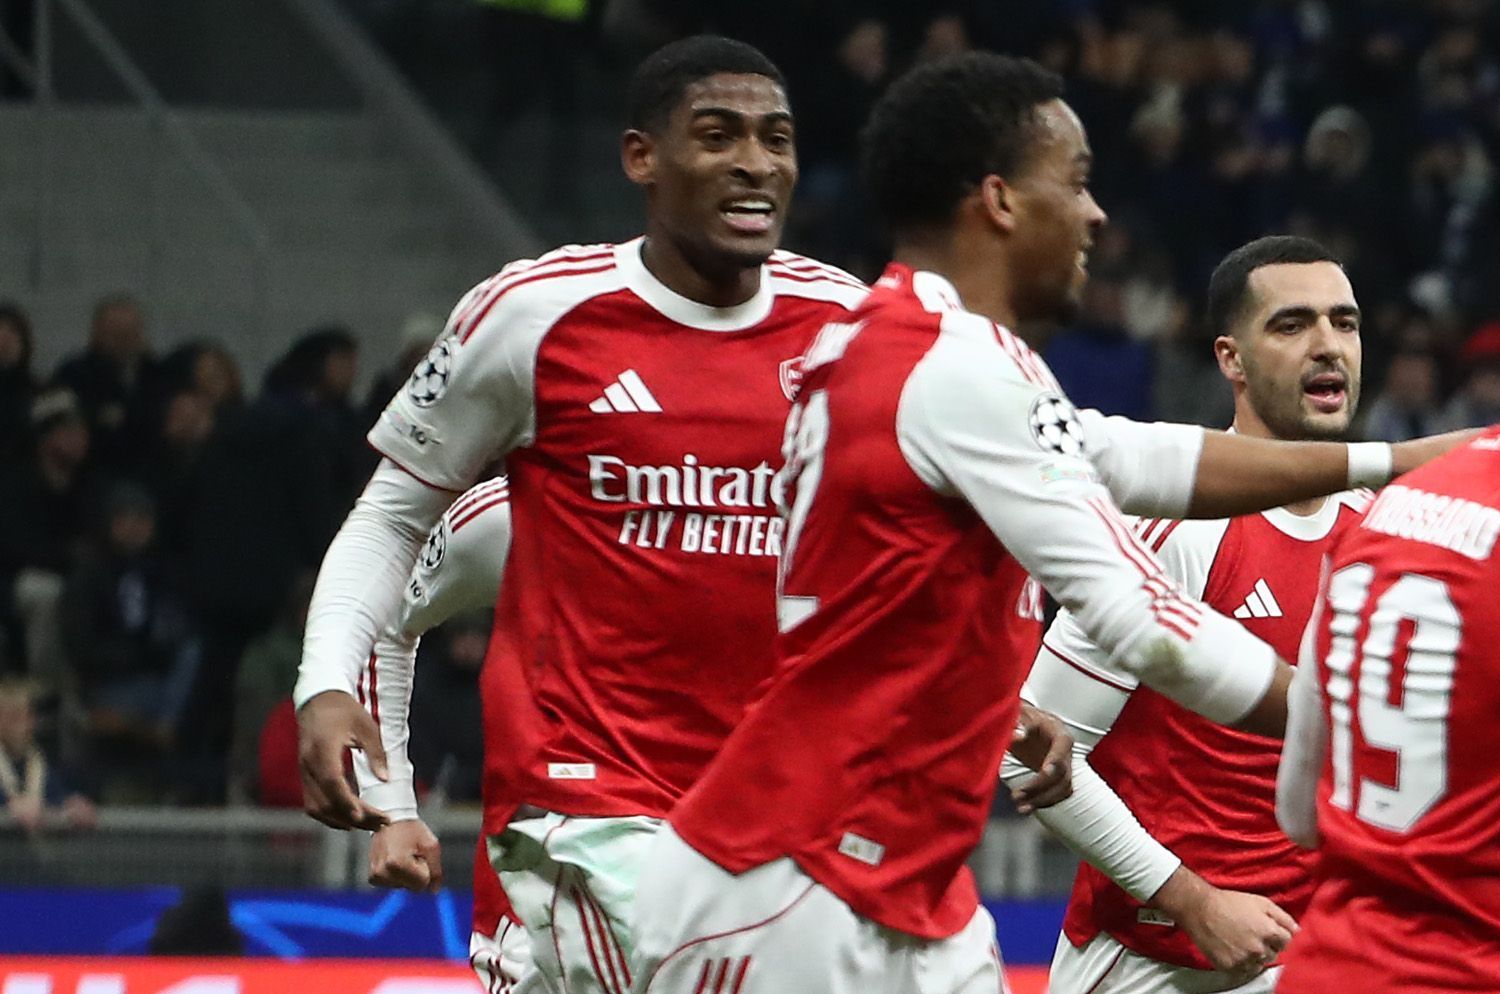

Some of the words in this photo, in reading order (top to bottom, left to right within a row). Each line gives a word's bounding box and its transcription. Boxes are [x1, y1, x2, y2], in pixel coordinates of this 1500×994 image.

[618, 511, 675, 549] FLY
[681, 512, 784, 556] BETTER
[1325, 562, 1463, 834] 19
